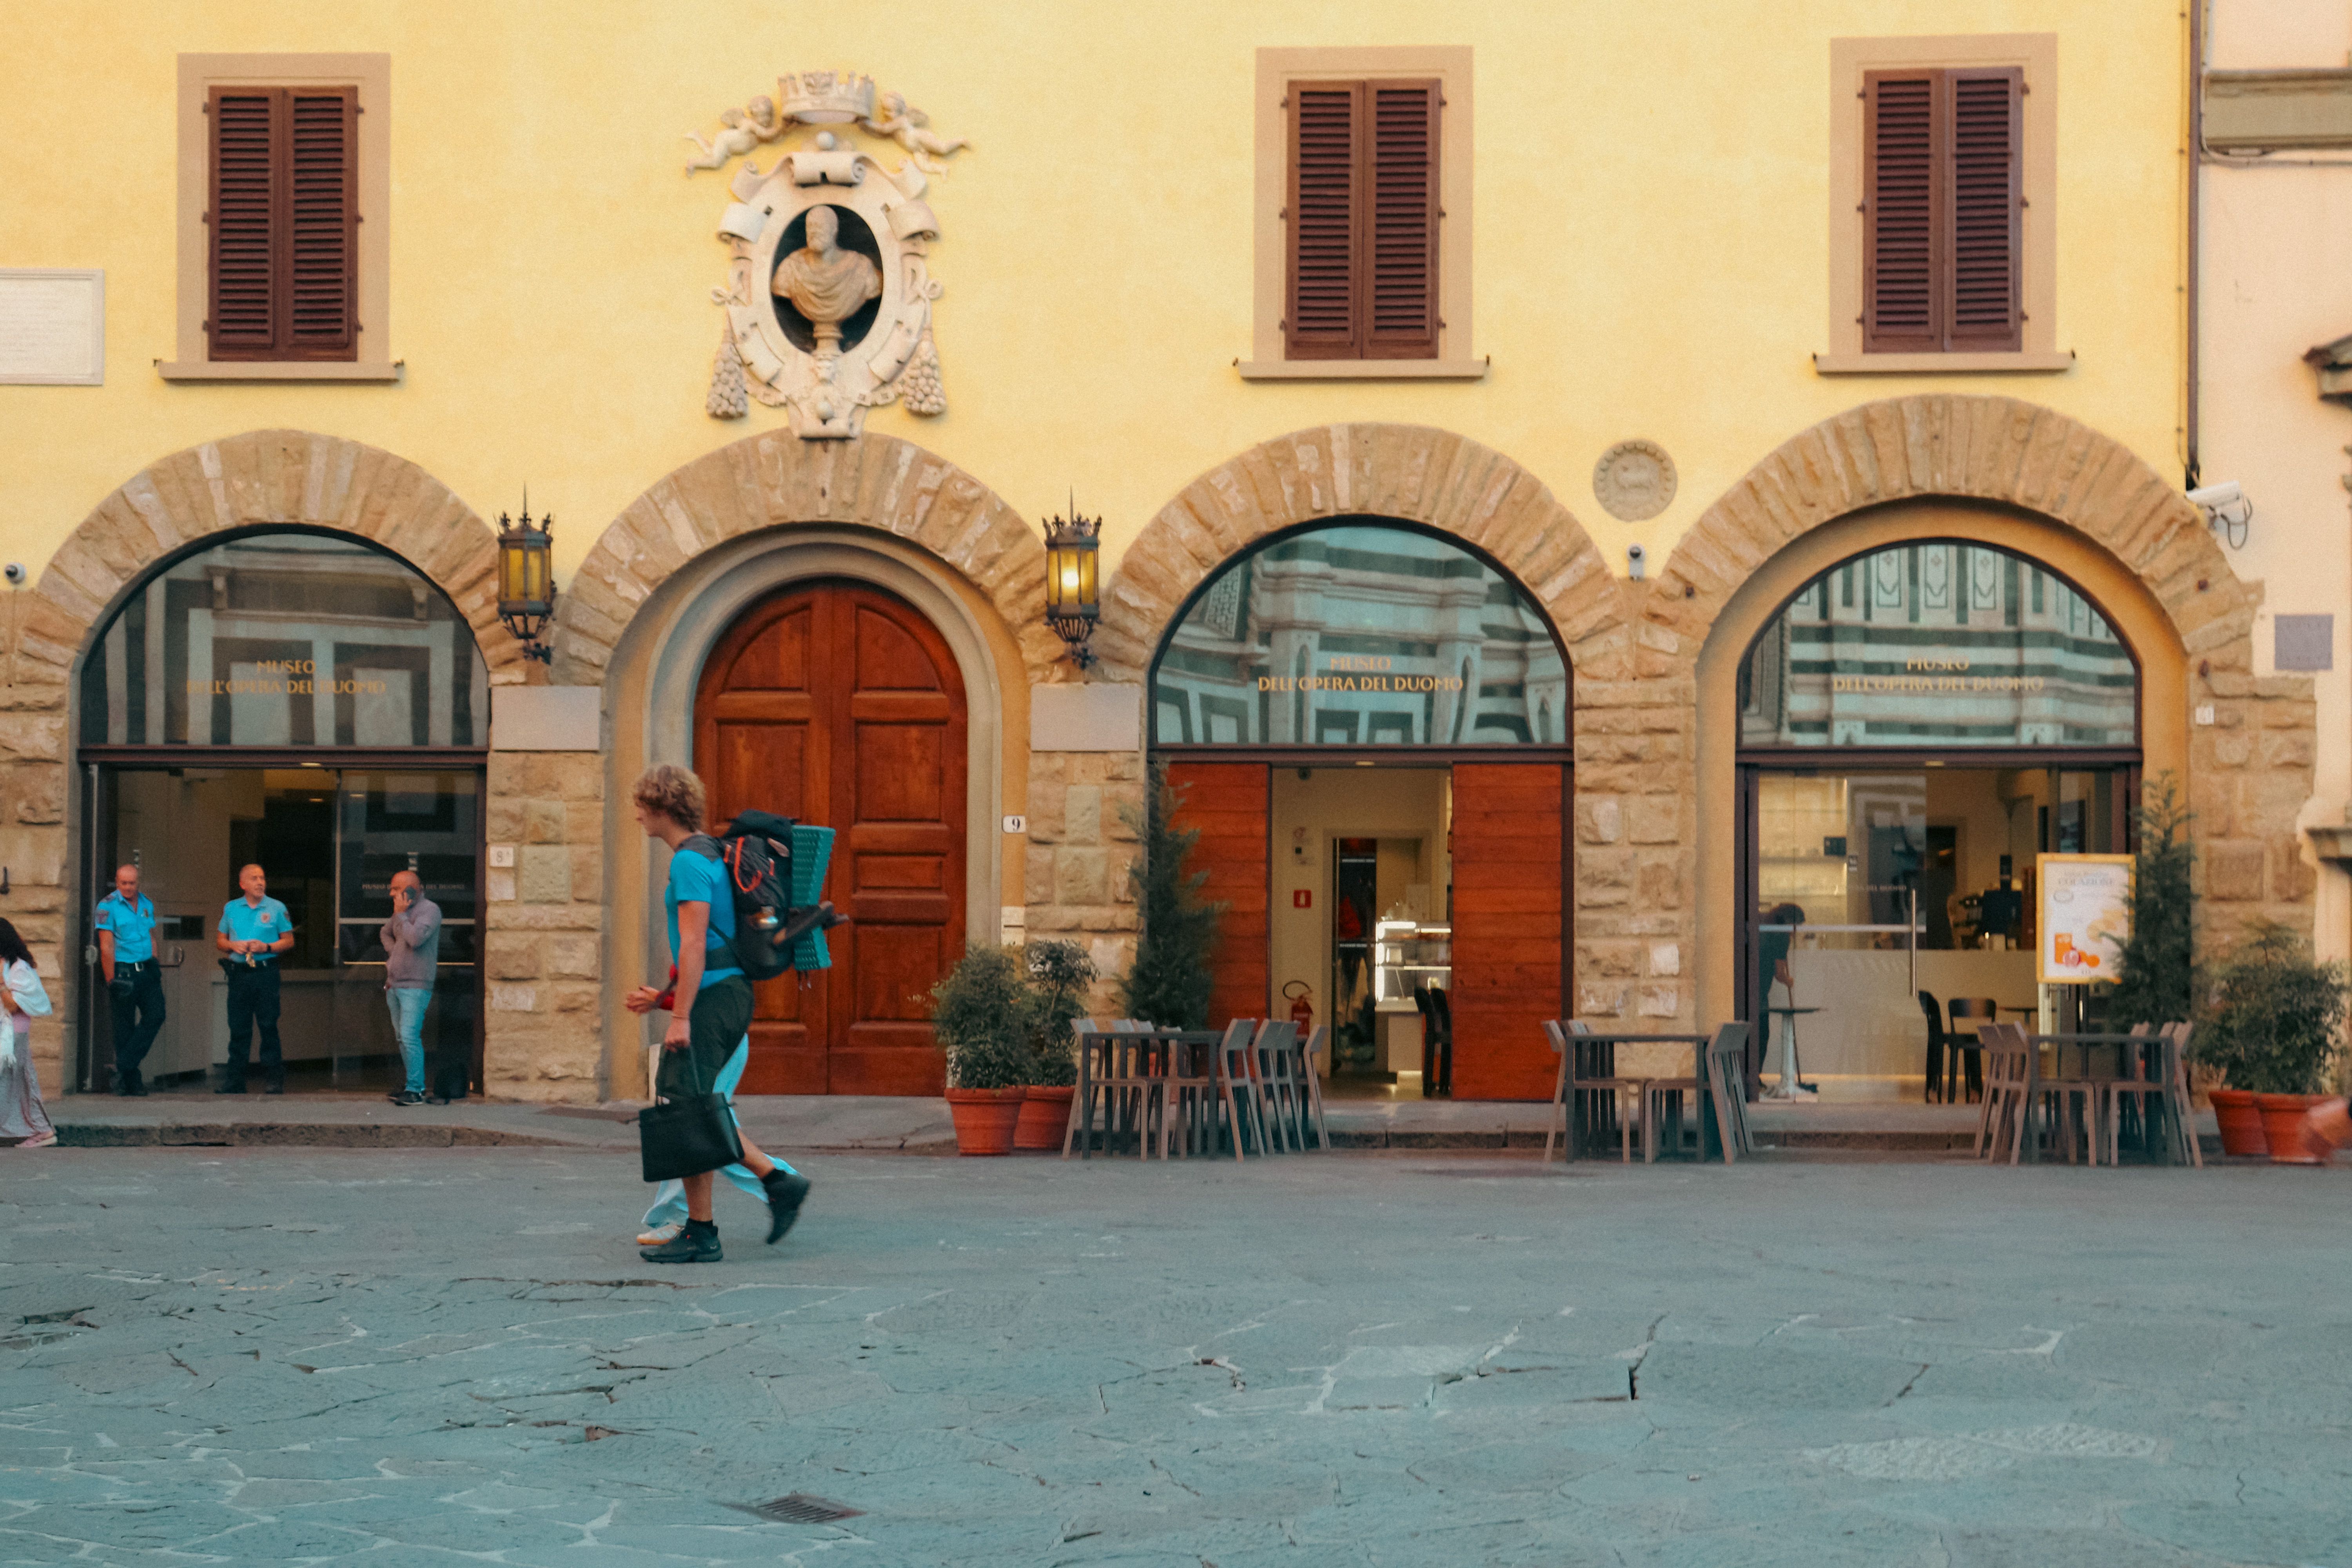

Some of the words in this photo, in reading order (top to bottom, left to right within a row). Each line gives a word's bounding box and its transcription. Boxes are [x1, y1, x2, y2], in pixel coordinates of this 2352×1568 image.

[257, 660, 316, 674] MUSEO
[1330, 656, 1391, 671] MUSEO
[1907, 657, 1969, 671] MUSEO
[287, 679, 314, 694] DEL
[319, 679, 387, 694] DUOMO
[1258, 676, 1357, 691] DELL'OPERA
[1361, 677, 1390, 691] DEL
[1394, 676, 1463, 691] DUOMO
[1938, 677, 1967, 691] DEL
[1973, 676, 2044, 691] DUOMO
[1011, 817, 1020, 831] 9
